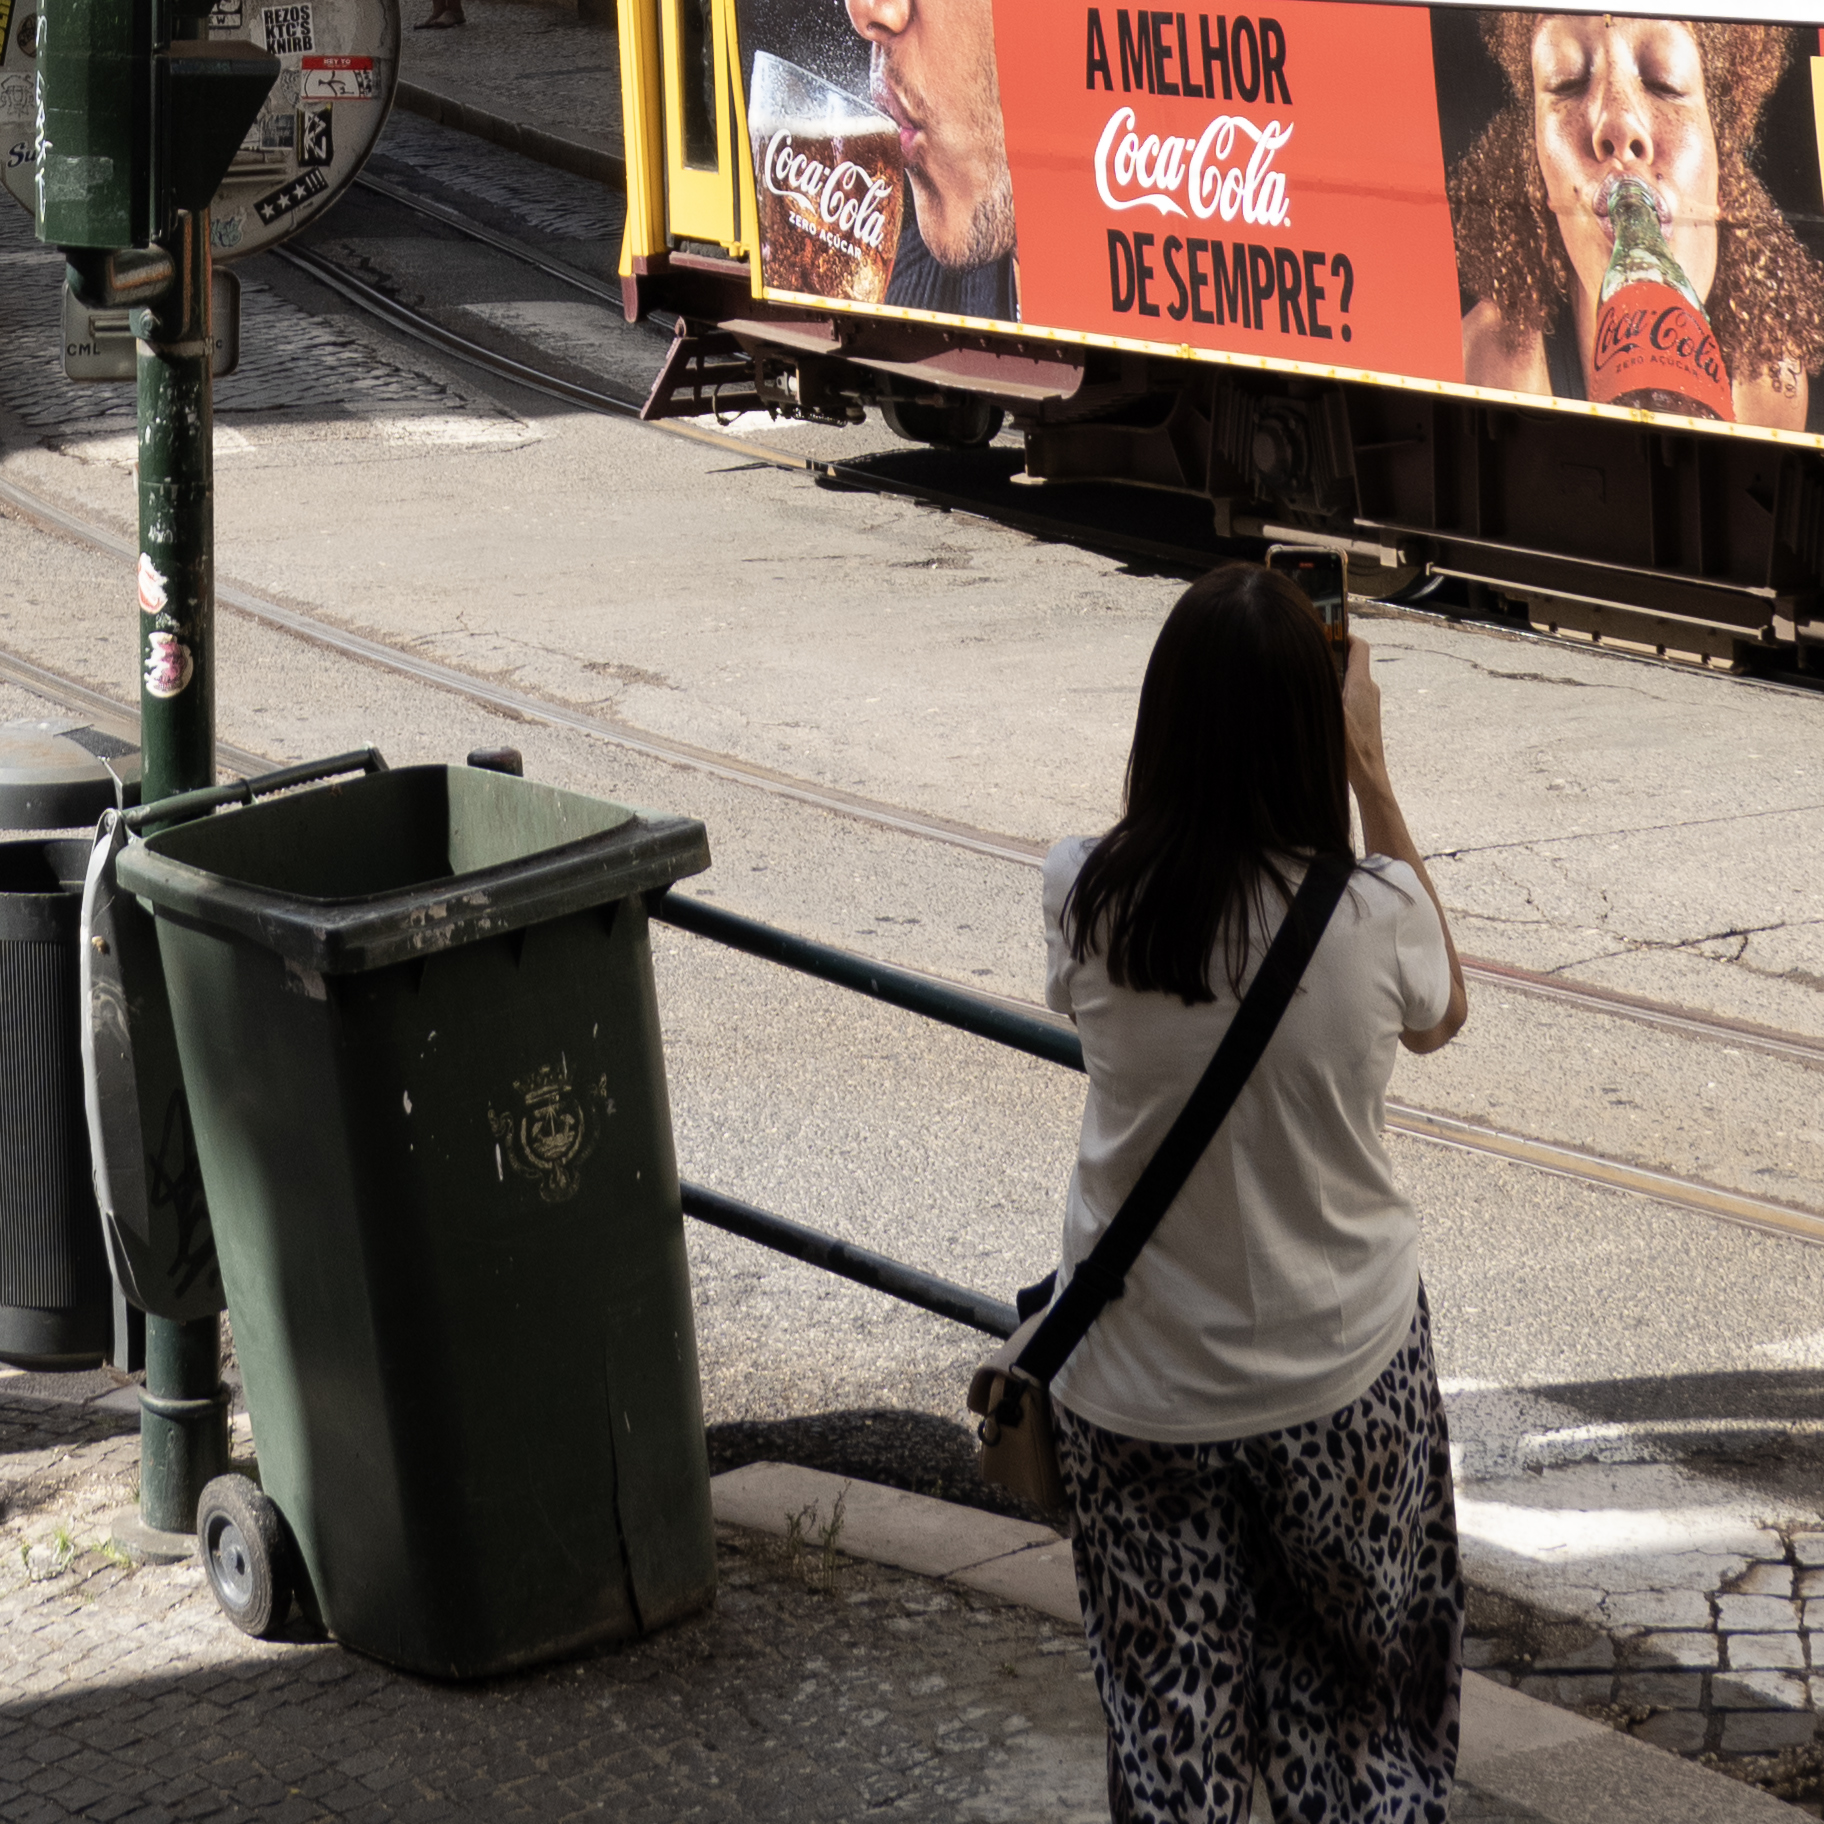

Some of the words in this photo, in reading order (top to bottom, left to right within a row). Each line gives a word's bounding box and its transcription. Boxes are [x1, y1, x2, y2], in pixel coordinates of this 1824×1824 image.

[263, 4, 311, 25] REZOS
[265, 21, 311, 40] KTC'S
[266, 36, 314, 55] KNIRB
[1086, 9, 1114, 92] A
[1117, 10, 1293, 106] MELHOR
[764, 128, 894, 252] Coca-Cola
[1094, 106, 1294, 228] Coca-Cola
[788, 210, 817, 236] ZERO
[818, 228, 863, 260] AÇÚCAR
[1108, 229, 1161, 317] DE
[1164, 234, 1356, 343] SEMPRE?
[67, 342, 101, 356] CML
[1594, 305, 1721, 384] Coca-Cola
[1615, 355, 1645, 374] ZERO
